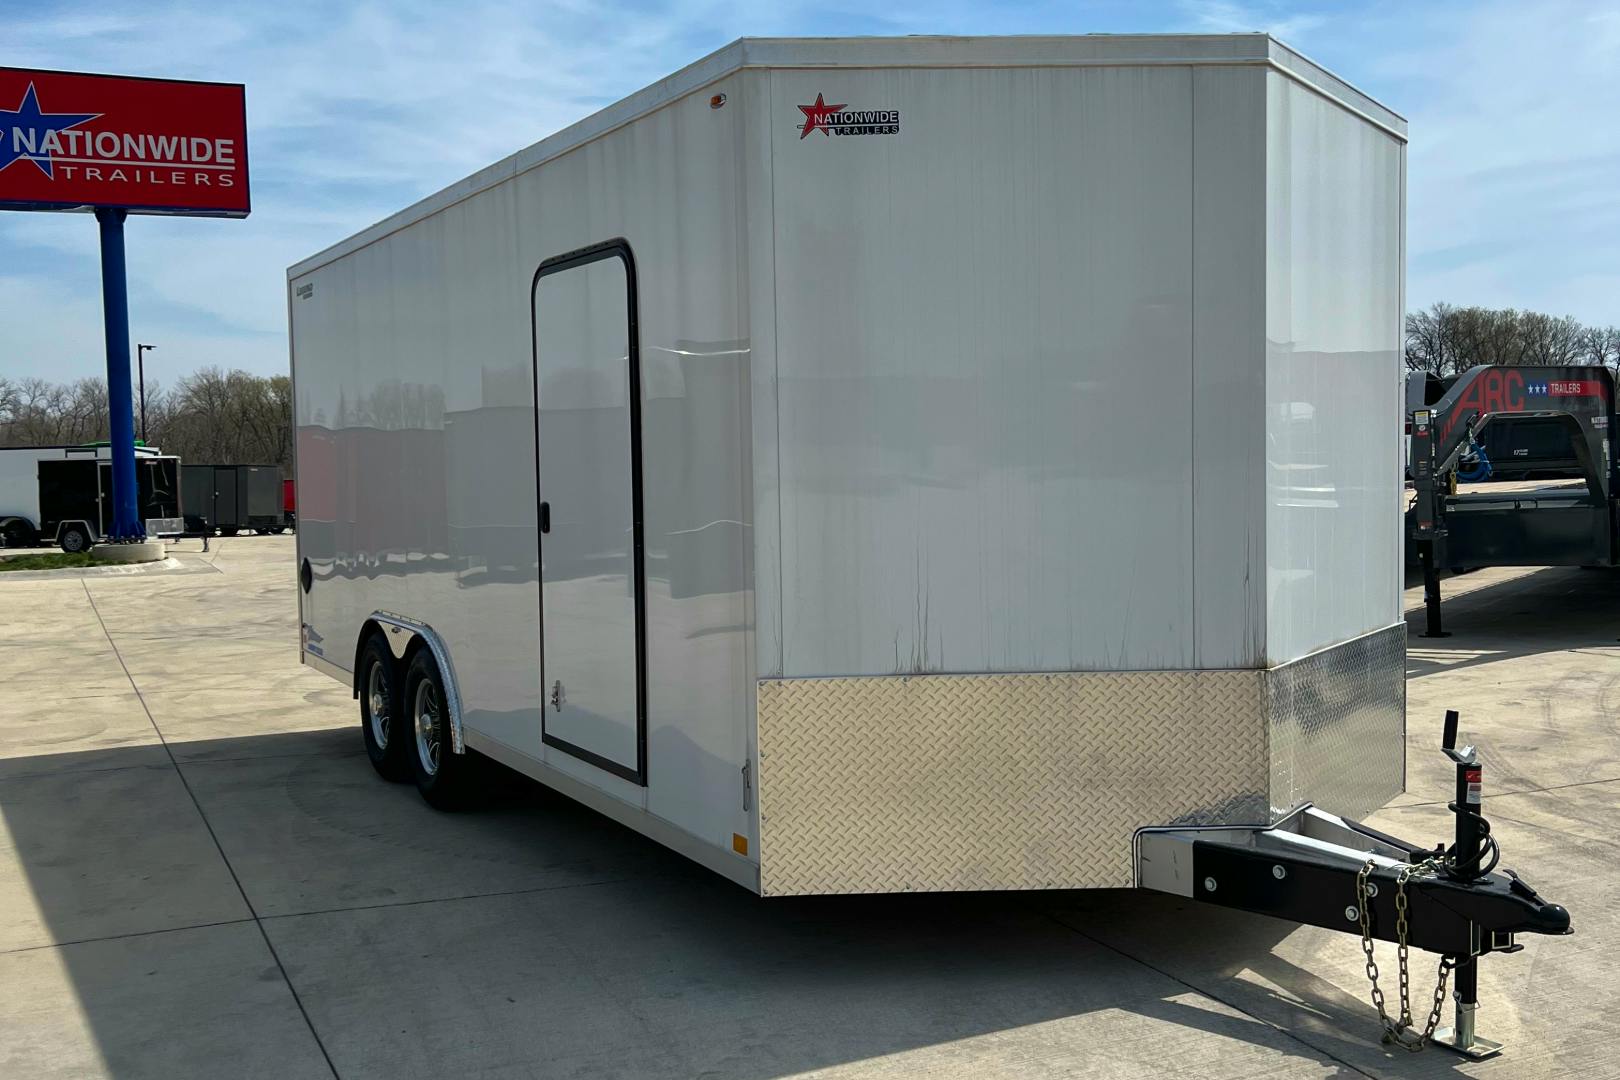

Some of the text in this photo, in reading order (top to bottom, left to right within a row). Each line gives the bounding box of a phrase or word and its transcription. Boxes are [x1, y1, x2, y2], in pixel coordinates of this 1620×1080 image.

[814, 111, 898, 124] NATIONWIDE
[836, 126, 898, 135] TRAILERS
[12, 126, 236, 164] NATIONWIDE
[59, 166, 234, 187] TRAILERS
[1550, 382, 1581, 394] TRAILERS
[1445, 369, 1525, 428] ARC
